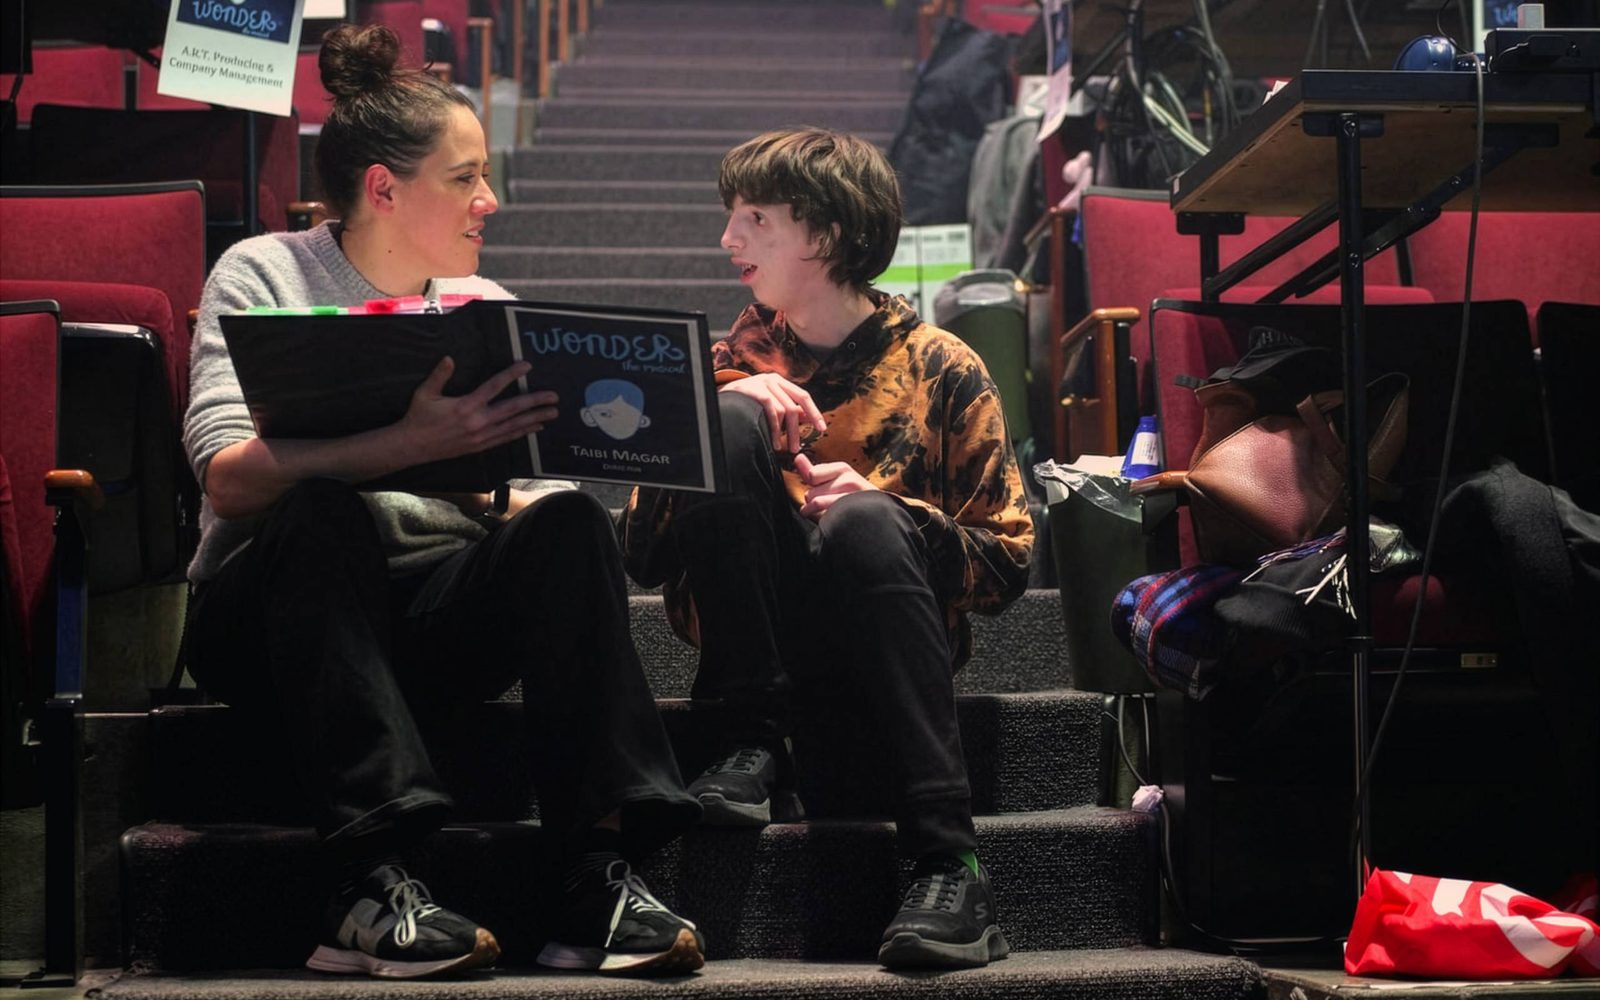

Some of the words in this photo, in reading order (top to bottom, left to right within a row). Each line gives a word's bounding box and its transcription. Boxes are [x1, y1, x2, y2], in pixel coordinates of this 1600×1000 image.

[192, 0, 277, 31] WONDER
[169, 57, 217, 77] Company
[219, 67, 284, 88] Management
[213, 51, 265, 73] Producing
[266, 63, 274, 73] &
[524, 327, 685, 362] WONDER
[569, 445, 608, 459] TAIBI
[612, 449, 671, 464] MAGAR
